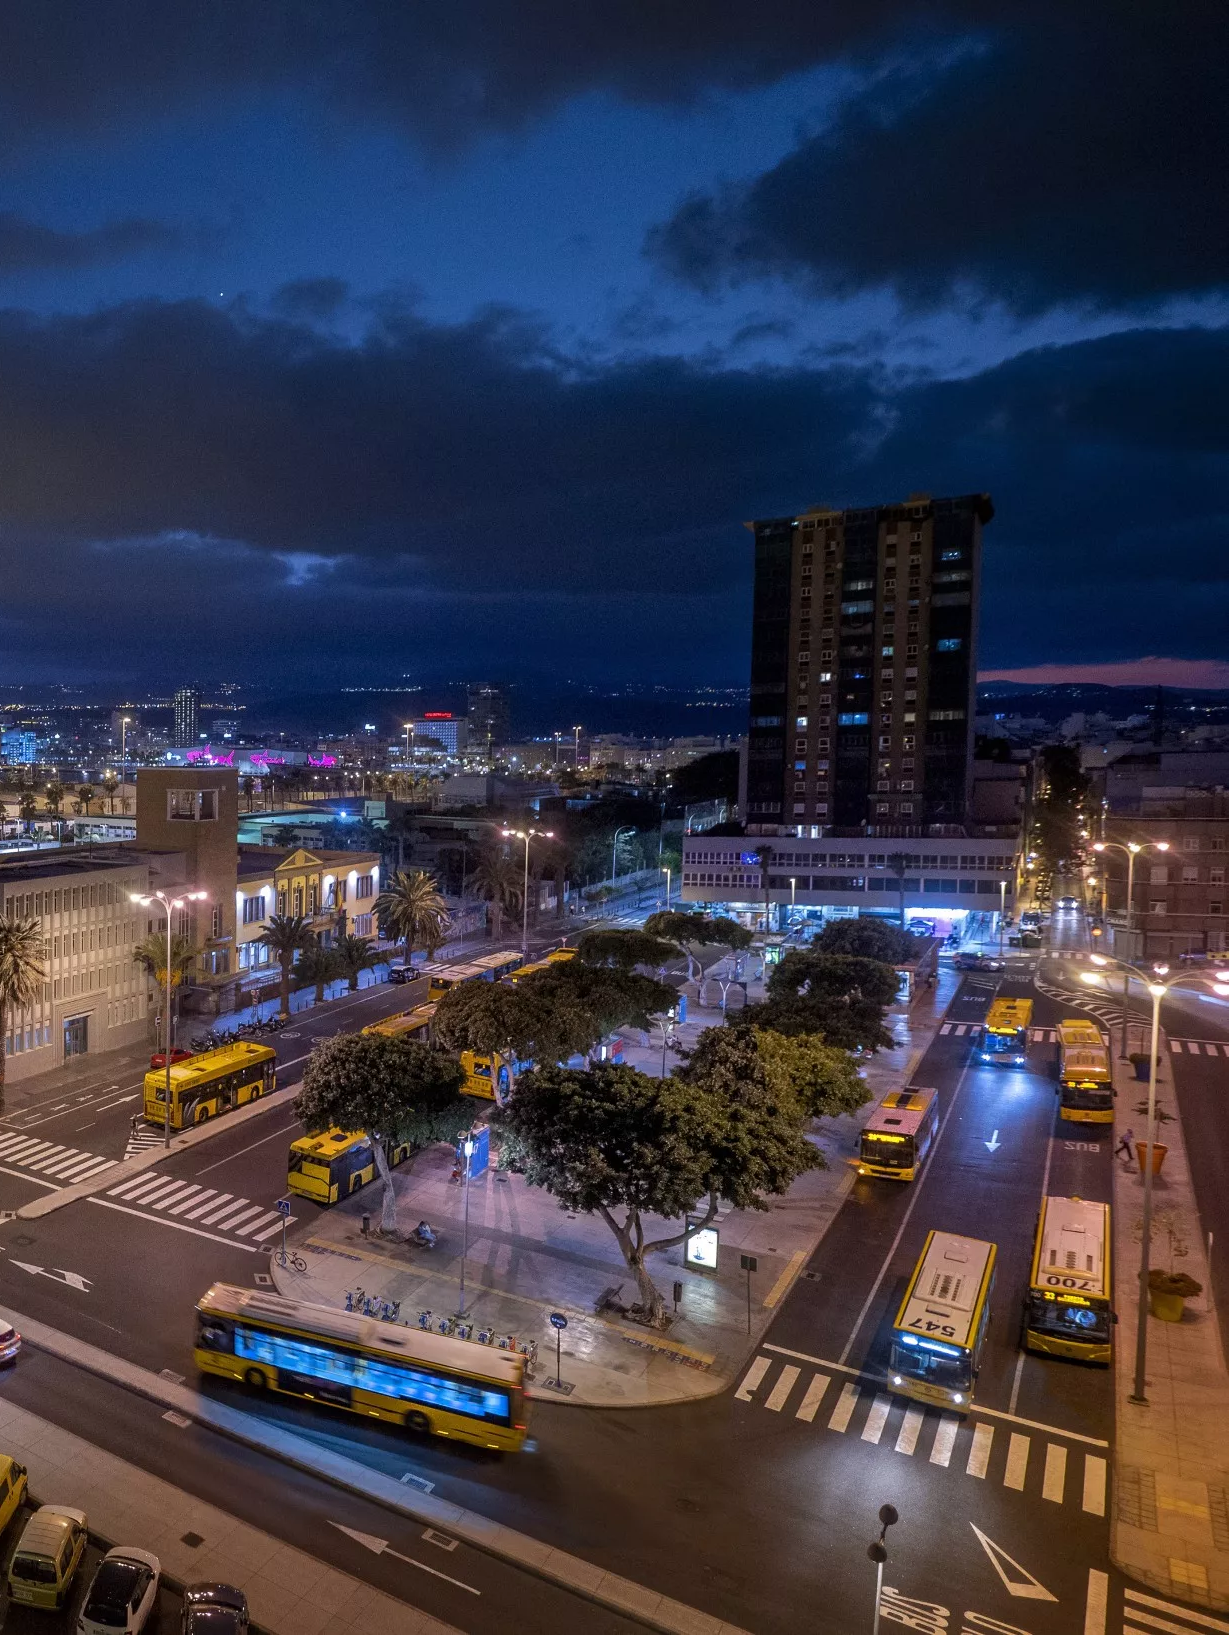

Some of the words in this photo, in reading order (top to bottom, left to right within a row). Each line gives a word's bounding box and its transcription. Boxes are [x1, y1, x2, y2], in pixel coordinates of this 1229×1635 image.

[1064, 1141, 1100, 1153] BUS
[1047, 1275, 1092, 1292] 700
[1044, 1291, 1056, 1300] 33
[908, 1318, 956, 1338] 547
[879, 1585, 951, 1635] BUS
